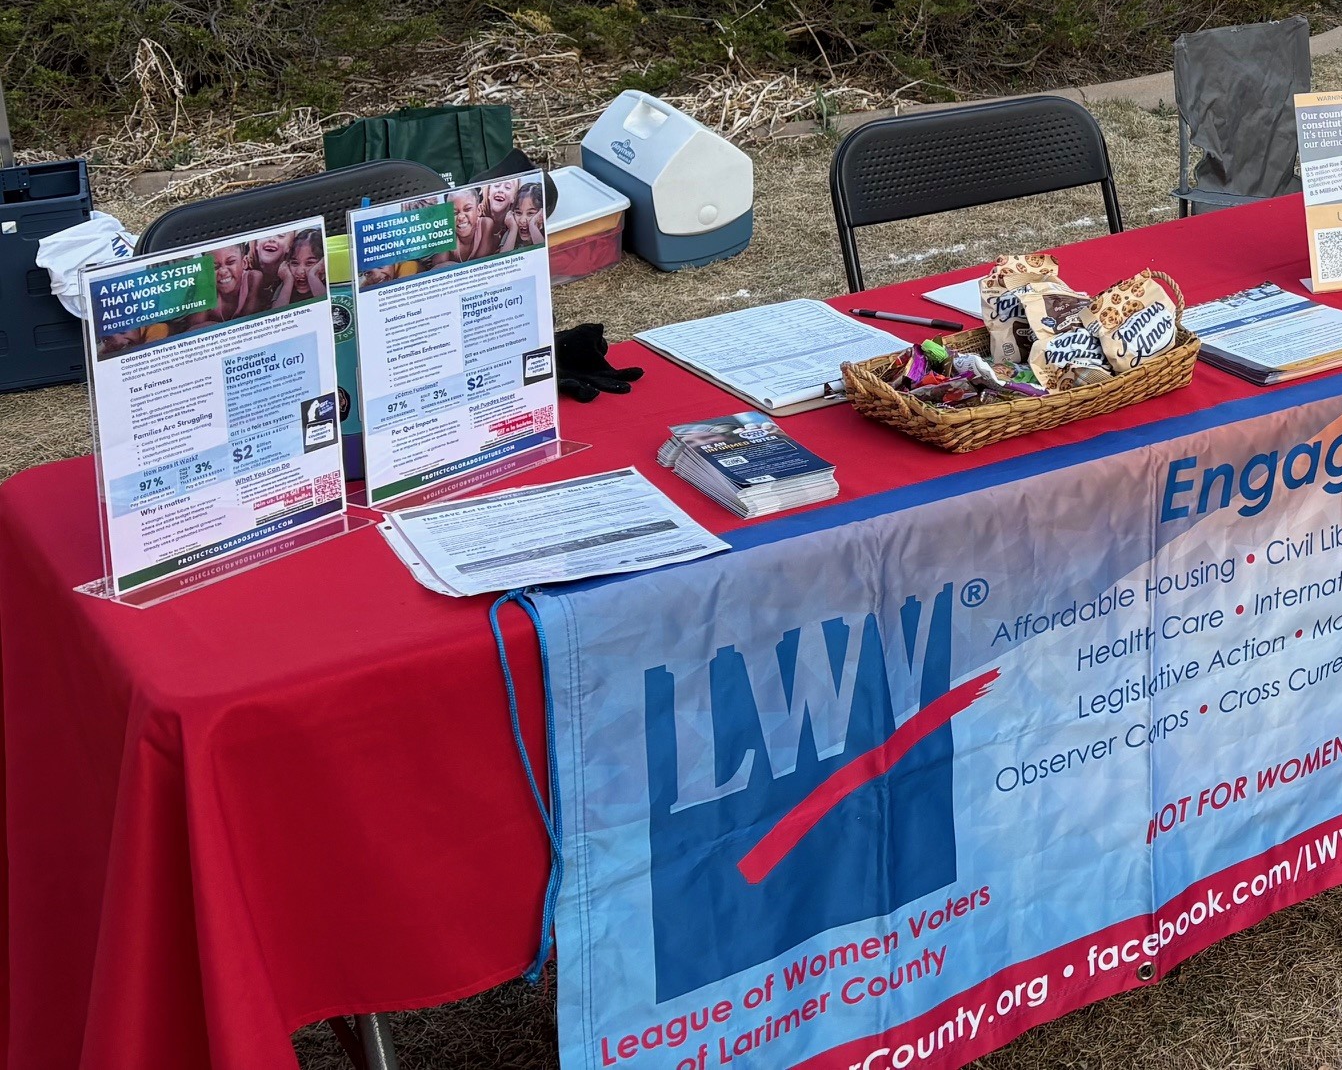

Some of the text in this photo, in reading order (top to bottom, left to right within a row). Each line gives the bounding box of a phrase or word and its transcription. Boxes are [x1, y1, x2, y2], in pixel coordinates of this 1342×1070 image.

[1301, 112, 1317, 120] Our
[1303, 131, 1316, 139] It's
[1318, 130, 1337, 138] time
[1304, 140, 1318, 148] our
[1320, 185, 1338, 195] Million
[362, 214, 420, 232] UN SISTEMA DE
[363, 219, 448, 243] IMPUESTOS JUSTO QUE
[364, 229, 453, 255] FUNCIONA PARA TODXS
[100, 263, 202, 295] A FAIR TAX SYSTEM
[101, 277, 195, 307] THAT WORKS FOR
[462, 294, 483, 303] Nuestra
[462, 296, 498, 310] Impuesto
[102, 300, 155, 321] ALL OF US
[103, 300, 206, 331] PROTECT COLORADO'S FUTURE
[385, 308, 422, 324] Justicia Fiscal
[463, 295, 523, 319] Progresivo (GIT)
[121, 308, 312, 364] Colorado Thrives When Everyone Contributes Their Fair Share.
[1111, 301, 1166, 357] Famous
[1129, 316, 1172, 367] Amos
[226, 353, 276, 375] Graduated
[387, 355, 397, 364] Las
[398, 349, 421, 360] Familias
[226, 353, 304, 384] Income Tax (GIT)
[144, 377, 172, 389] Fairness
[433, 388, 447, 400] 3%
[467, 375, 483, 391] $2
[388, 400, 408, 413] 97%
[134, 428, 162, 441] Families
[178, 413, 212, 426] Struggling
[392, 418, 438, 436] Por Qué Importa
[233, 445, 253, 463] $2
[705, 436, 778, 453] INFORMED VOTER
[195, 461, 212, 474] 3%
[139, 477, 164, 492] 97%
[141, 508, 156, 517] Why
[164, 496, 190, 509] matters
[178, 519, 293, 566] PROTECTCOLORADOSFUTURE.COM
[990, 585, 1136, 648] Affordable
[1145, 555, 1236, 605] Housing
[1265, 532, 1314, 568] Civil
[1076, 625, 1156, 672] Health
[1162, 606, 1224, 646] Care
[1078, 660, 1199, 720] Legislative
[1208, 634, 1286, 672] Action
[660, 586, 941, 814] LWV
[996, 735, 1118, 794] Observer
[1125, 708, 1190, 755] Corps
[1218, 680, 1280, 716] Cross
[1146, 795, 1192, 845] NOT
[1196, 775, 1248, 818] FOR
[602, 884, 991, 1067] League of Women Voters
[675, 944, 947, 1070] of Larimer County
[848, 972, 1049, 1070] County.org
